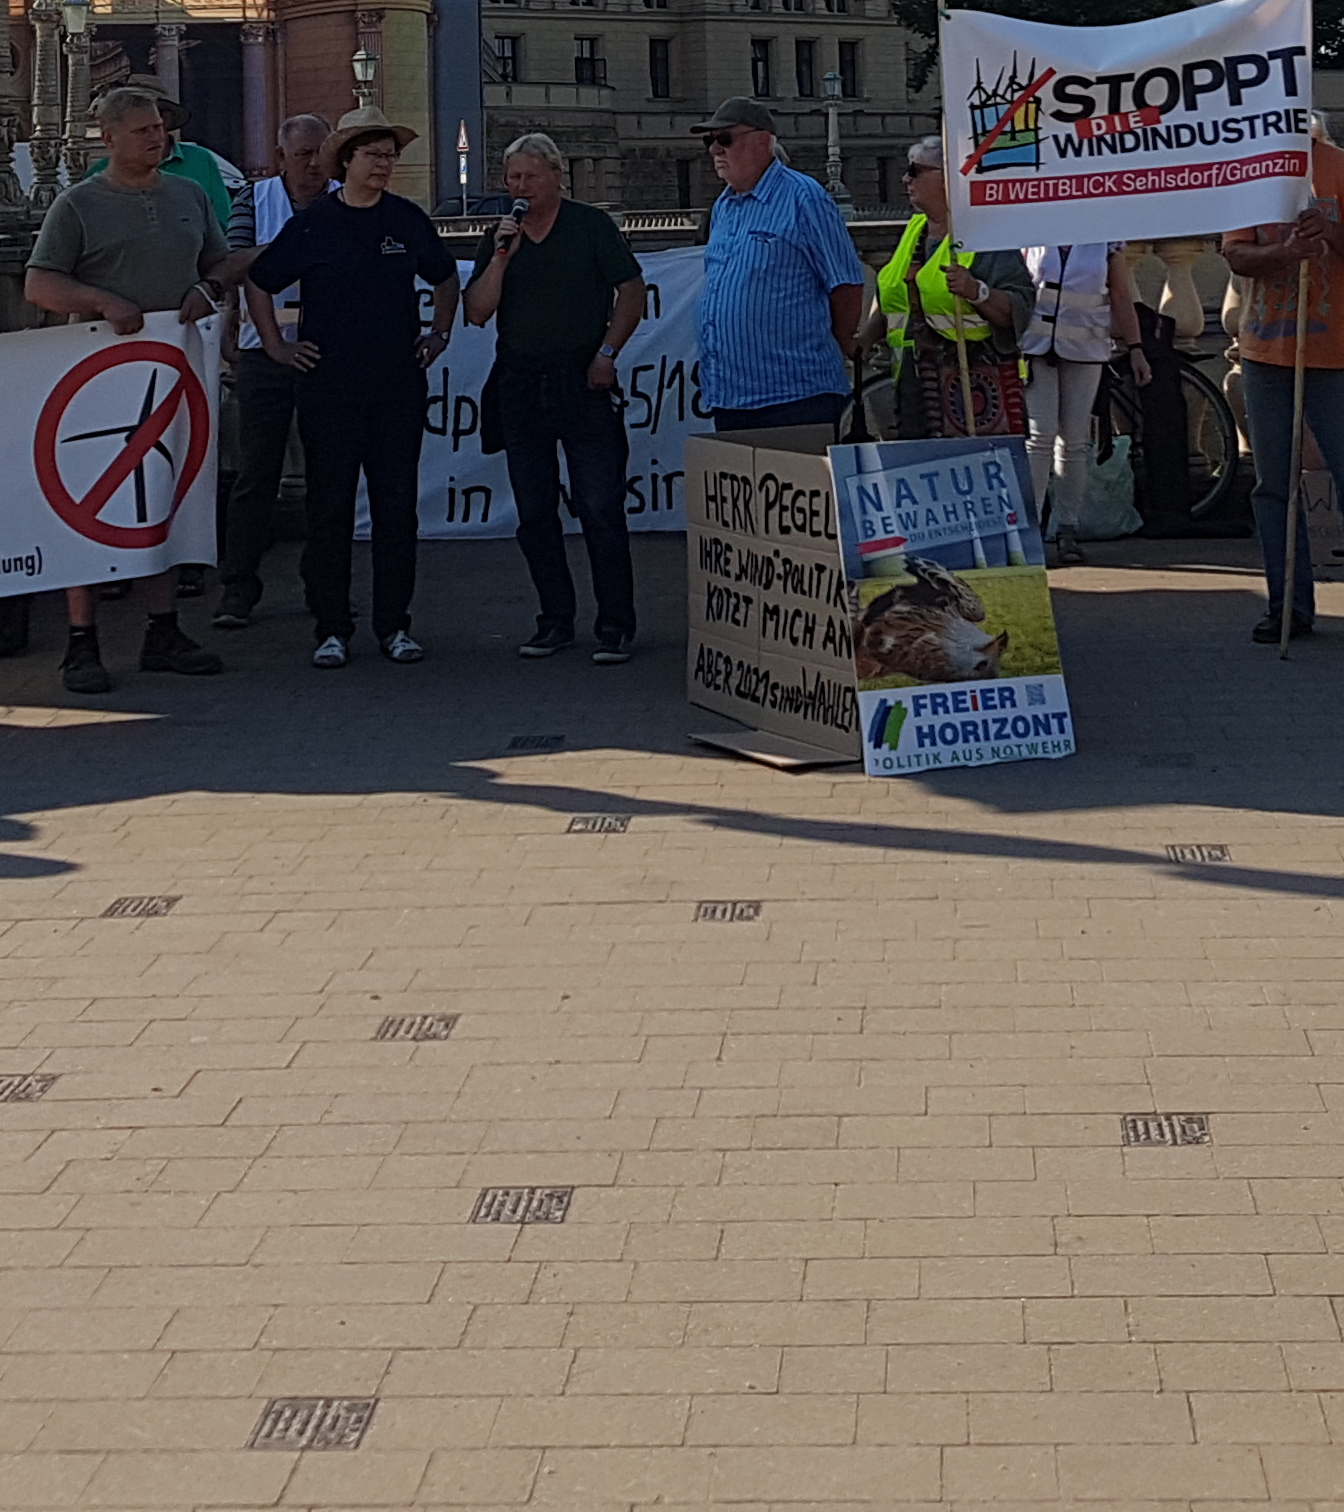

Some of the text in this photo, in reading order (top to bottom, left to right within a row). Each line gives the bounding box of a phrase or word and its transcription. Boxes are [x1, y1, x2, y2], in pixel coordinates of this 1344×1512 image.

[1050, 46, 1307, 123] STOPPT
[1052, 108, 1308, 160] WINDINDUSTRIE
[1090, 111, 1145, 137] DIE
[985, 155, 1300, 202] BI WEITBLICK Sehlsdorf/Granzin
[704, 470, 838, 539] HERR PEGEL
[857, 460, 1008, 516] NATUR
[862, 493, 1017, 538] BEWAHREN
[909, 531, 925, 543] DU
[699, 535, 733, 579] IHRE
[706, 581, 852, 660] KOTZT MICH AN
[694, 643, 733, 697] ABER
[769, 681, 804, 714] SIND
[915, 711, 1068, 749] HORIZONT
[950, 748, 985, 764] AUS
[990, 738, 1074, 760] NOTWEHR
